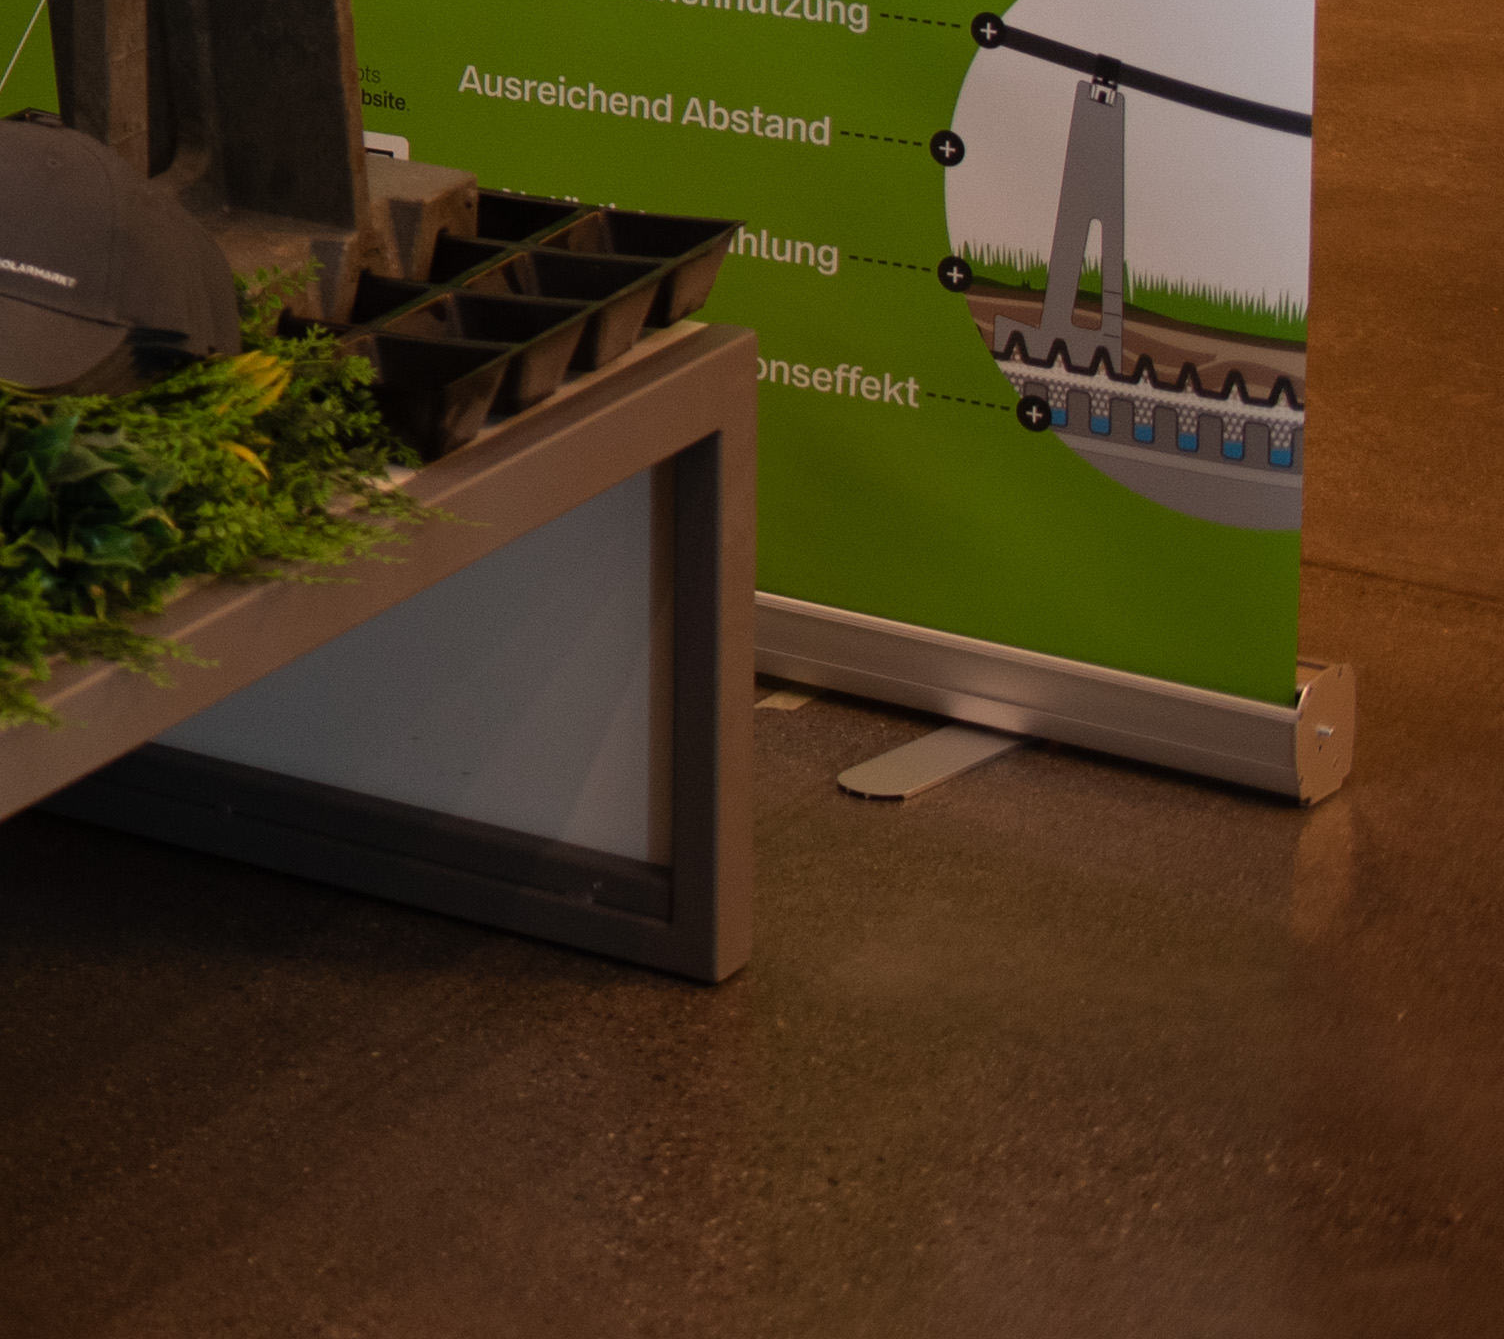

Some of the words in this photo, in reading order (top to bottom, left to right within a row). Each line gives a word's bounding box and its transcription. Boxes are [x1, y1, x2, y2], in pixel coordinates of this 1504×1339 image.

[458, 65, 673, 123] Ausreichend
[683, 95, 831, 148] Abstand
[755, 353, 920, 409] onseffekt
